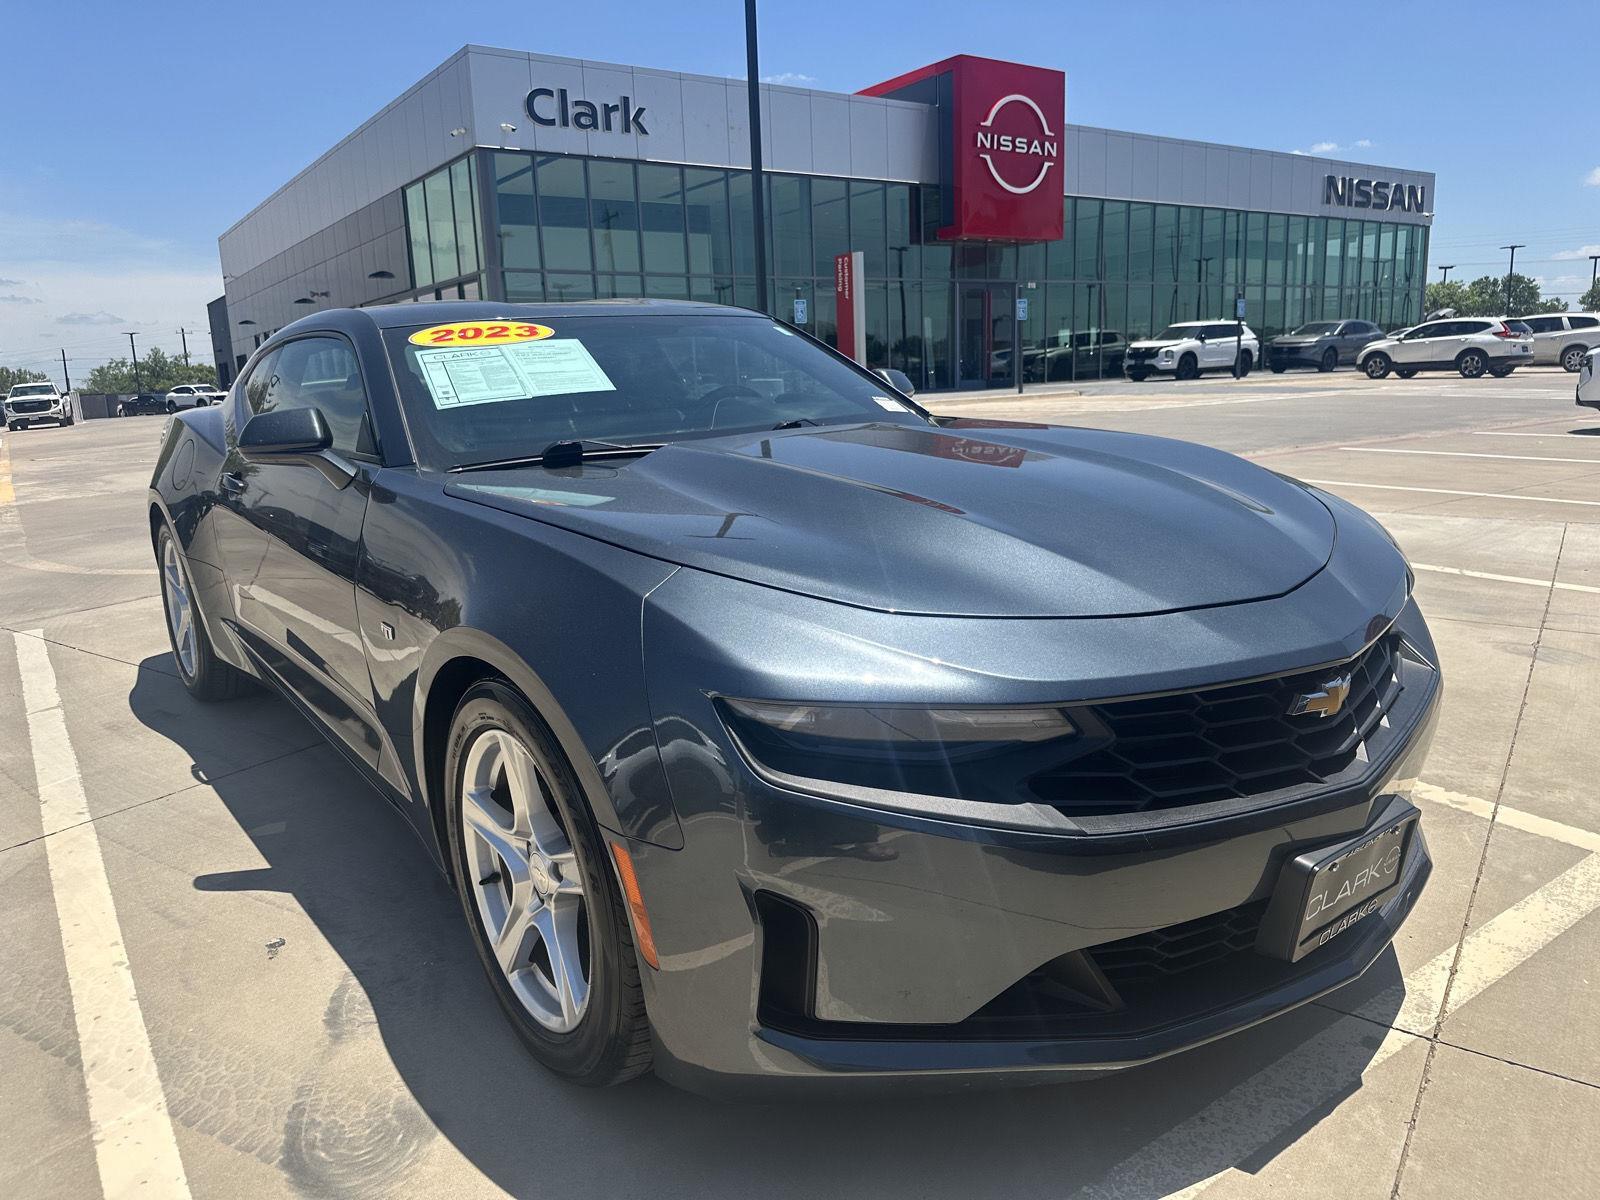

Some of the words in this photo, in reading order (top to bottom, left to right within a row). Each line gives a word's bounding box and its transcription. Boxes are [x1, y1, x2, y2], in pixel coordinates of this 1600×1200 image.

[525, 88, 649, 135] Clark
[977, 131, 1058, 157] NISSAN
[1325, 175, 1425, 213] NISSAN
[430, 325, 539, 343] 2023
[1305, 856, 1383, 922] CLARK
[1319, 905, 1370, 946] CLARK
